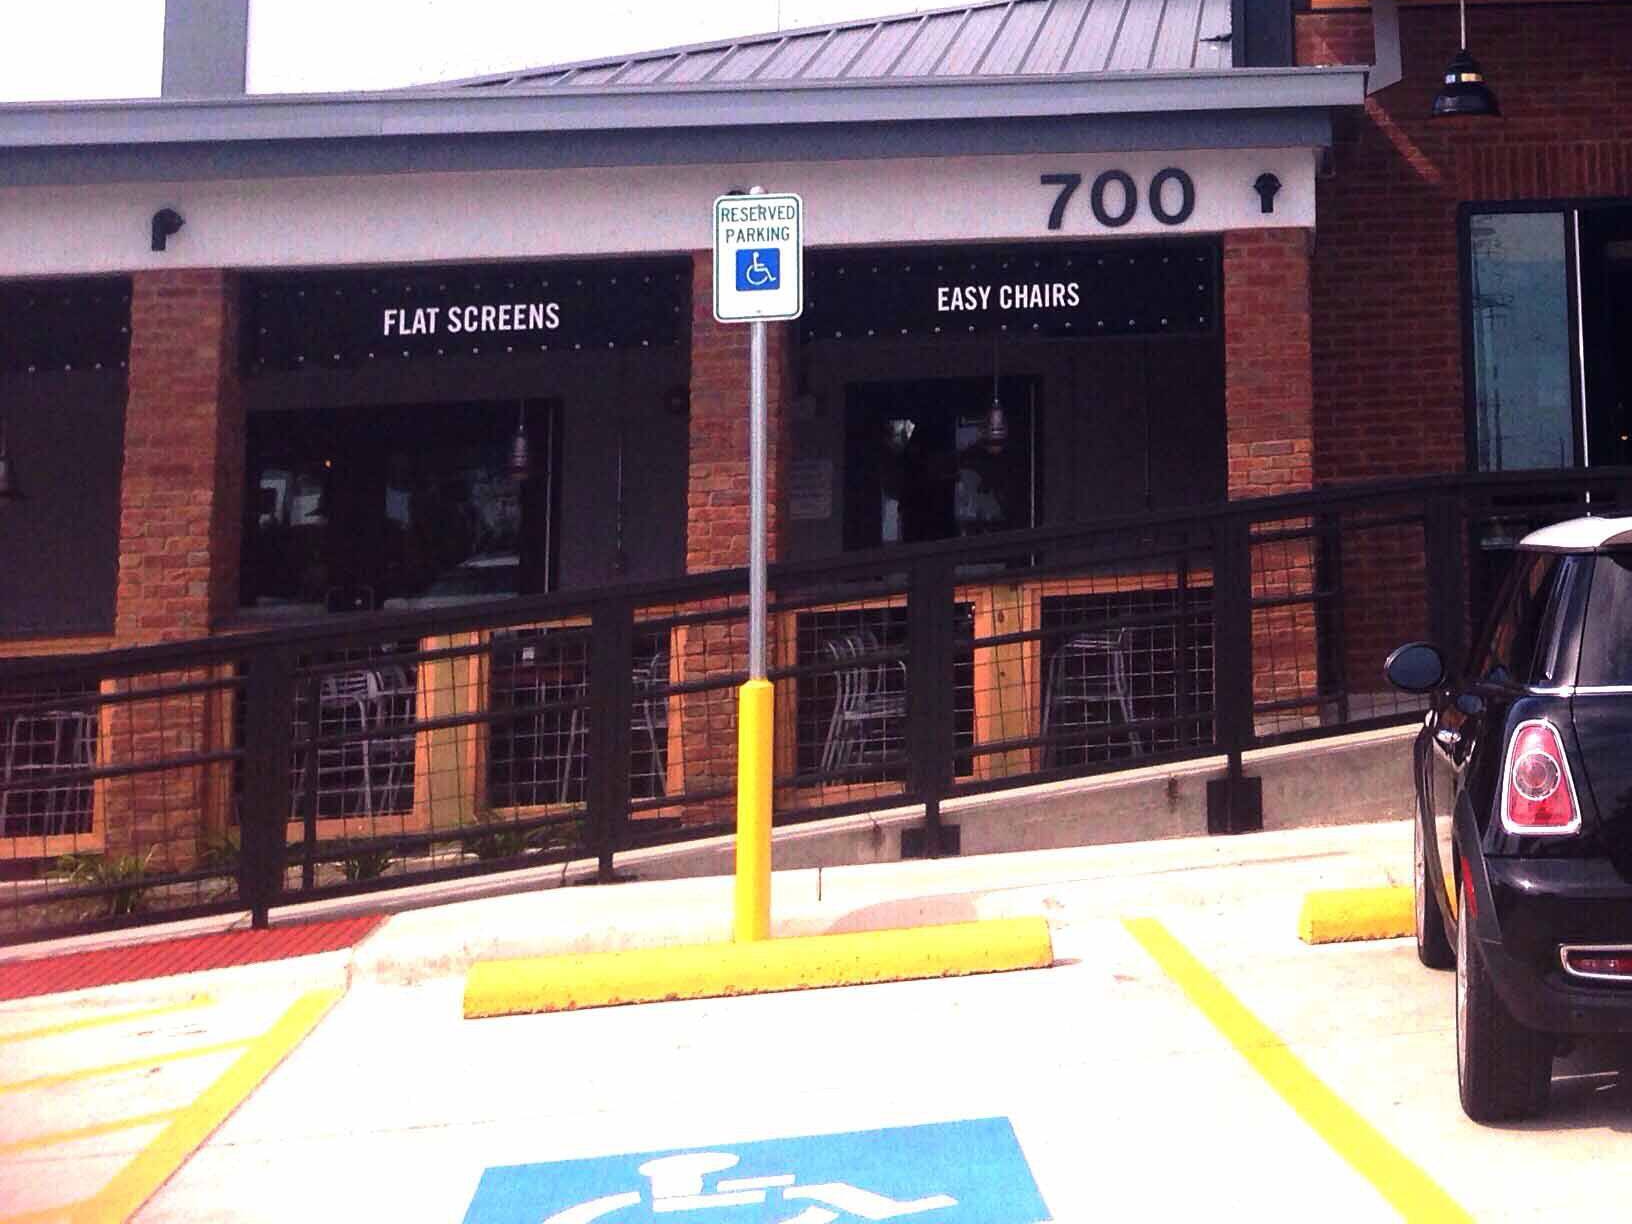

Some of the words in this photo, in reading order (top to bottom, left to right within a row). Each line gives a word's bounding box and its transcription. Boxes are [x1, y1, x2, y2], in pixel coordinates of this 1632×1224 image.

[721, 204, 796, 223] RESERVED
[1040, 167, 1195, 230] 700
[725, 225, 790, 244] PARKING
[937, 285, 991, 312] EASY
[999, 282, 1080, 309] CHAIRS
[383, 307, 440, 337] FLAT
[447, 302, 560, 334] SCREENS
